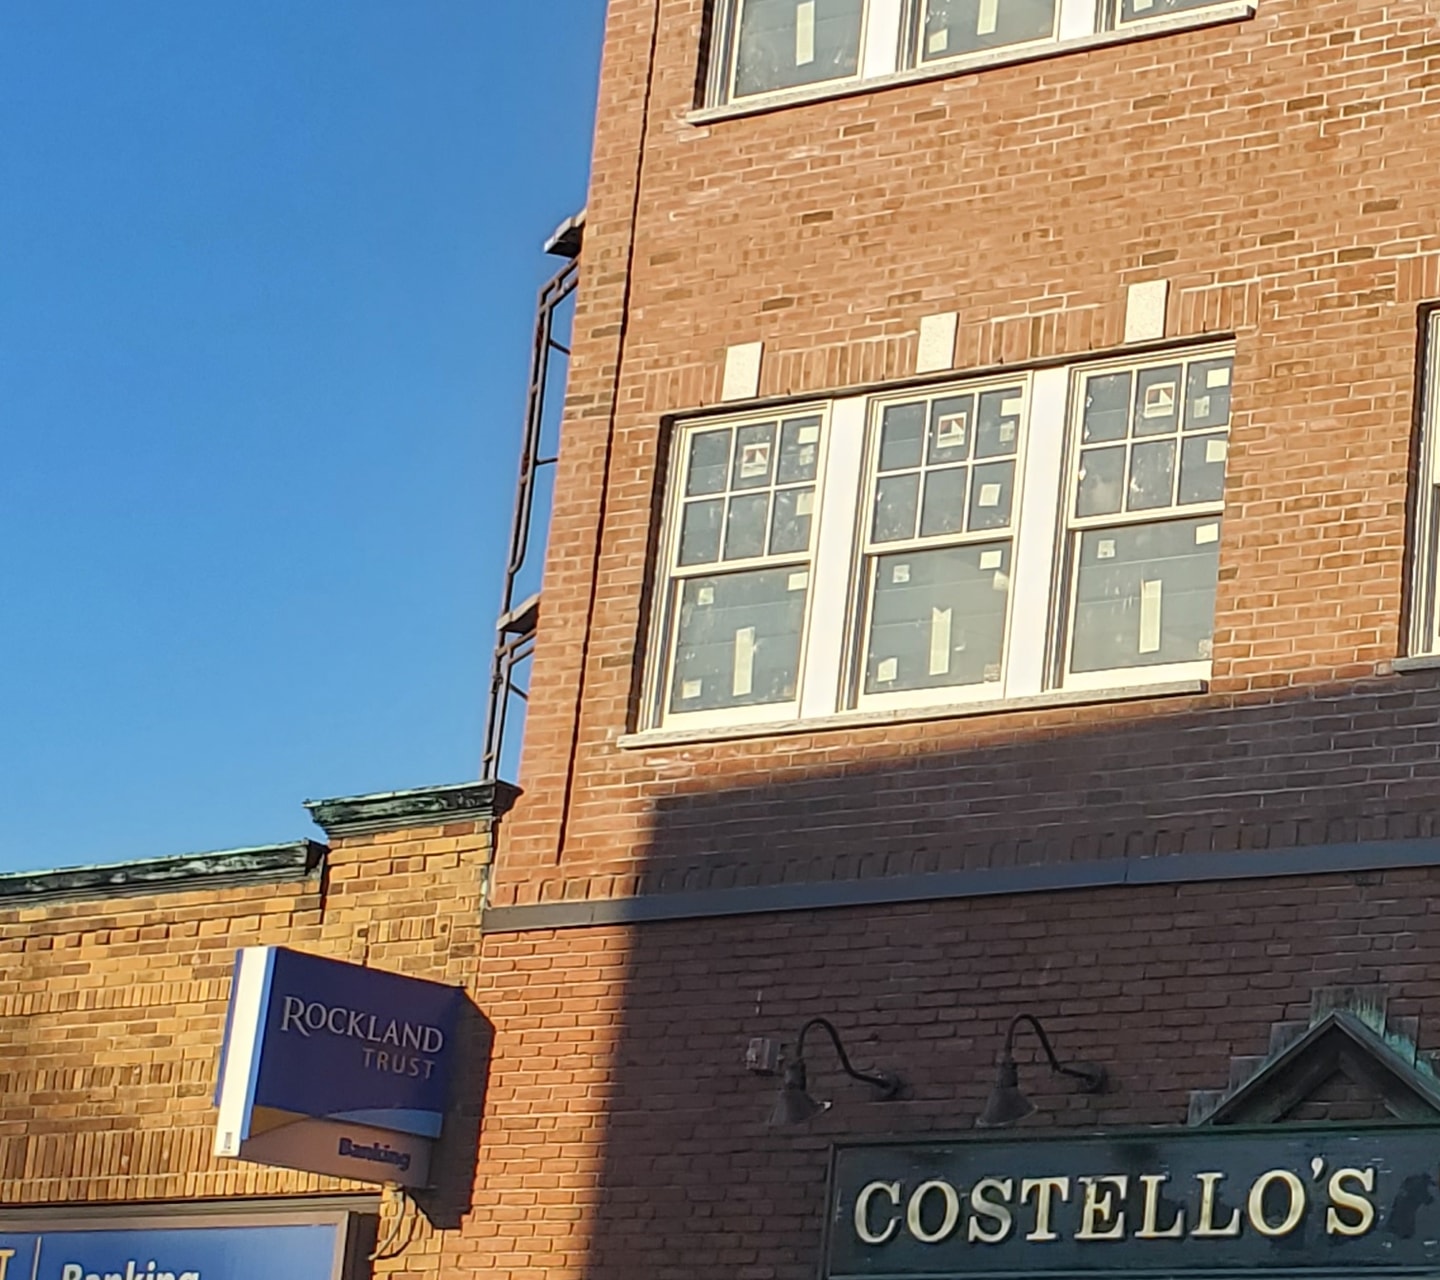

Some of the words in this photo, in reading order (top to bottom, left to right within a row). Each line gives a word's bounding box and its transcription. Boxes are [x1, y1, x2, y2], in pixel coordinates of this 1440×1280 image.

[280, 995, 444, 1054] ROCKLAND
[363, 1047, 435, 1080] TRUST
[338, 1137, 411, 1172] Banking
[853, 1156, 1376, 1244] COSTELLO'S
